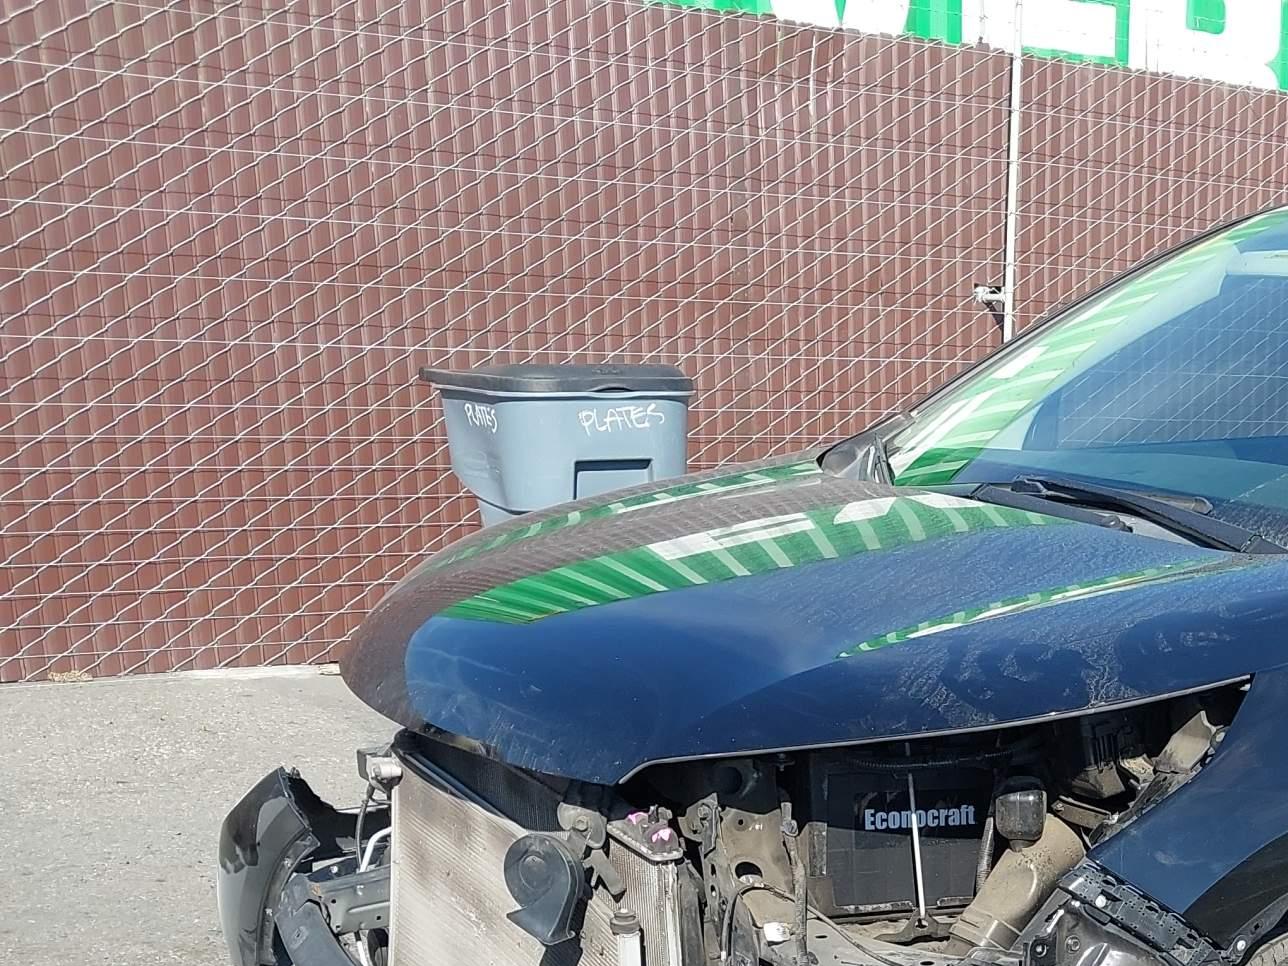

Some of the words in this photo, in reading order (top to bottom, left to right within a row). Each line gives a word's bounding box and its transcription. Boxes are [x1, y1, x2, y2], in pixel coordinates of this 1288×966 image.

[464, 403, 498, 434] PLATES
[578, 403, 665, 436] PLATES
[864, 804, 977, 831] Econocraft
